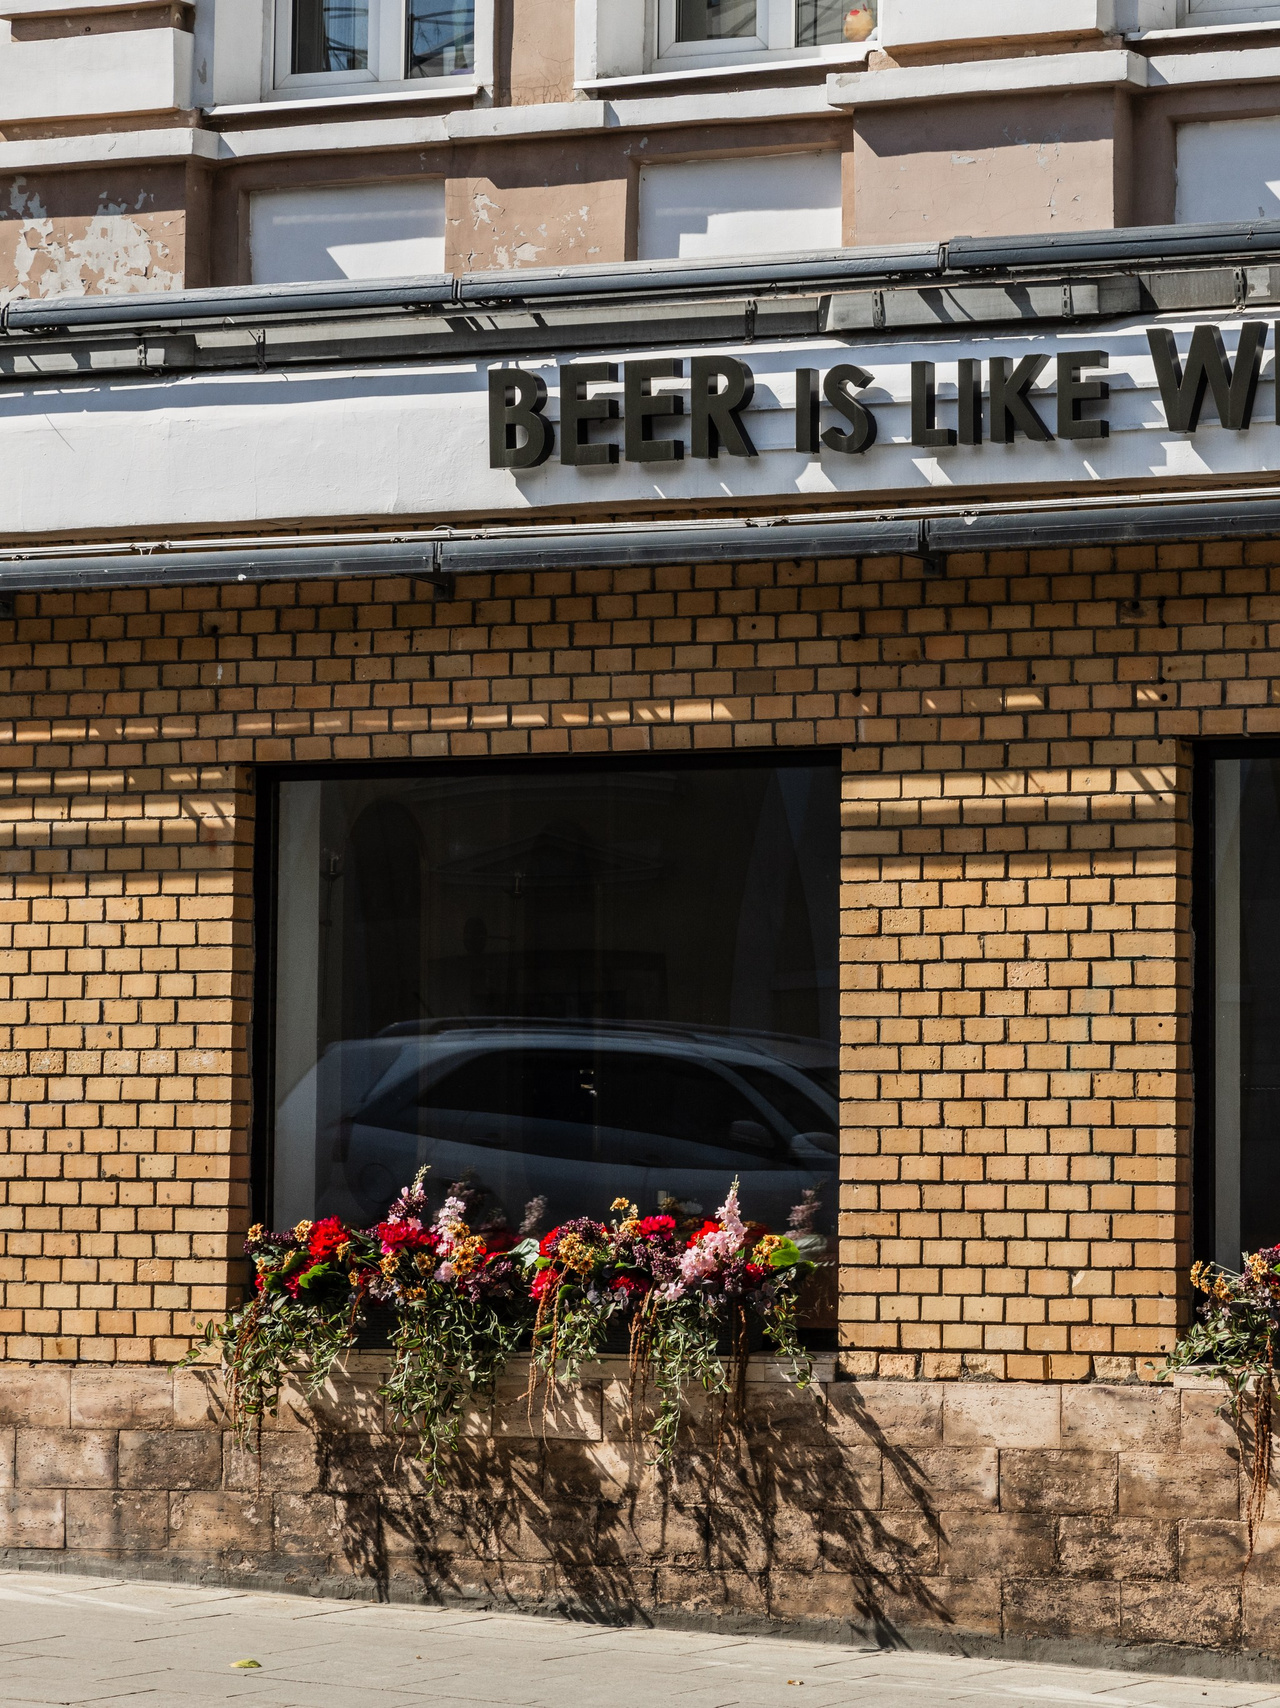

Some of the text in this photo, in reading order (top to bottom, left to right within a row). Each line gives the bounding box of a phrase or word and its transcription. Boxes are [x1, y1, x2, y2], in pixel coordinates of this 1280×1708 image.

[489, 356, 758, 469] BEER
[796, 364, 877, 454] IS
[911, 350, 1109, 447] LIKE
